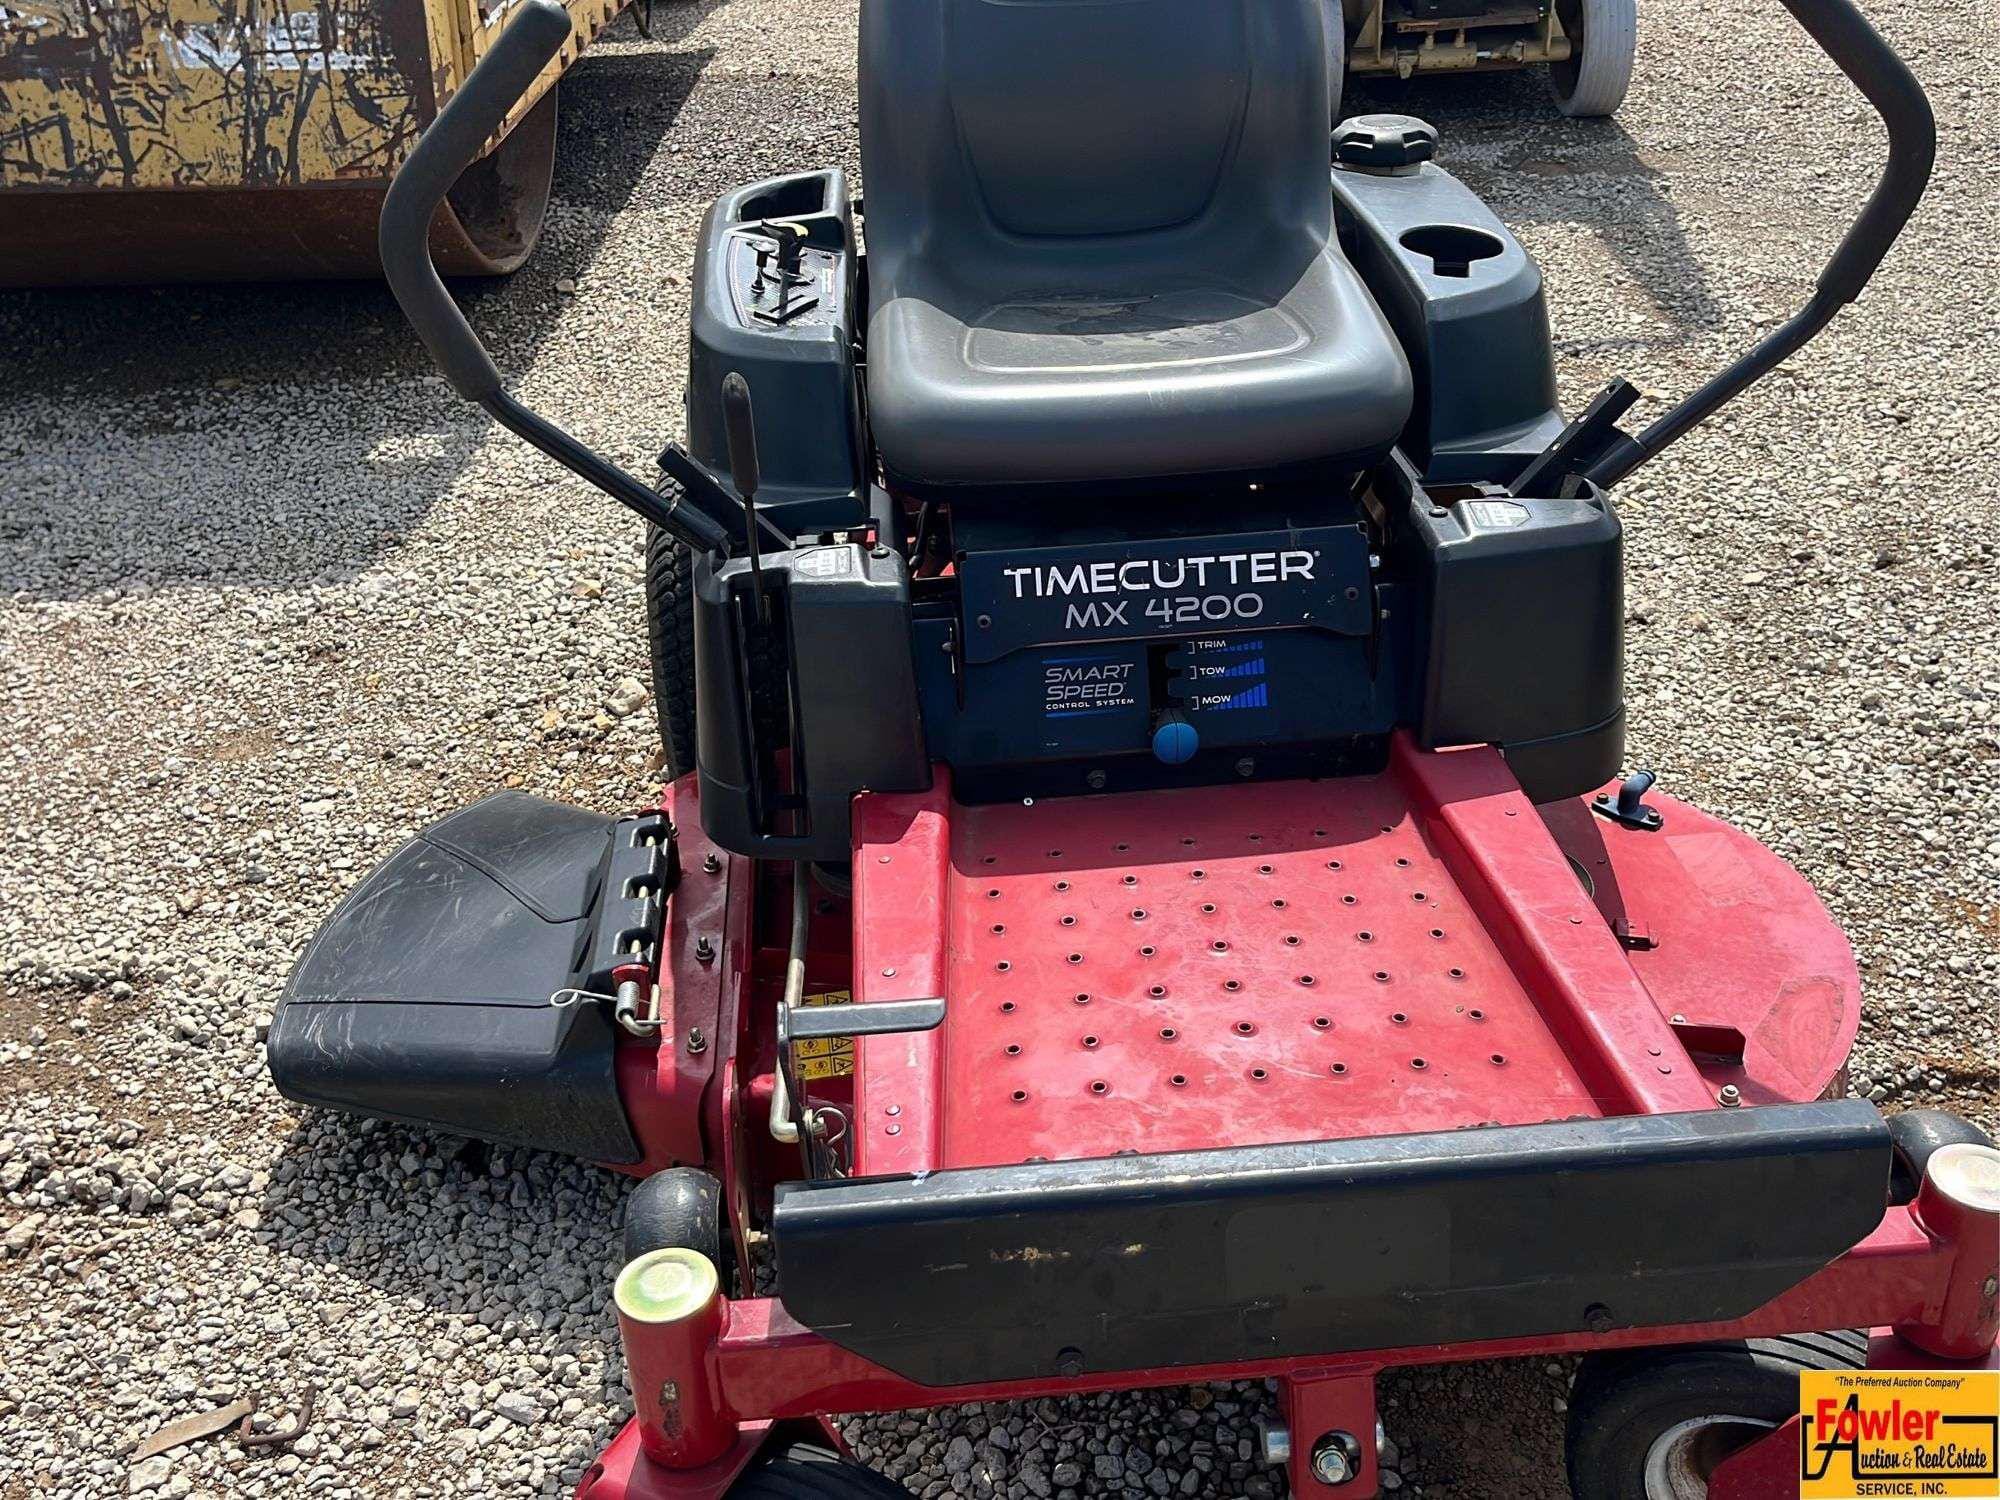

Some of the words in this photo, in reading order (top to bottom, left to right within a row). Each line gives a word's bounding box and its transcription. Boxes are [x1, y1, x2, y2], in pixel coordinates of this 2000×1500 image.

[1065, 600, 1129, 629] MX
[1145, 592, 1264, 623] 4200
[1197, 640, 1227, 649] TRIM
[1045, 663, 1135, 683] SMART
[1199, 666, 1226, 675] TOW
[1045, 701, 1091, 710] CONTROL
[1096, 698, 1135, 707] SYSTEM
[1202, 695, 1232, 705] MOW
